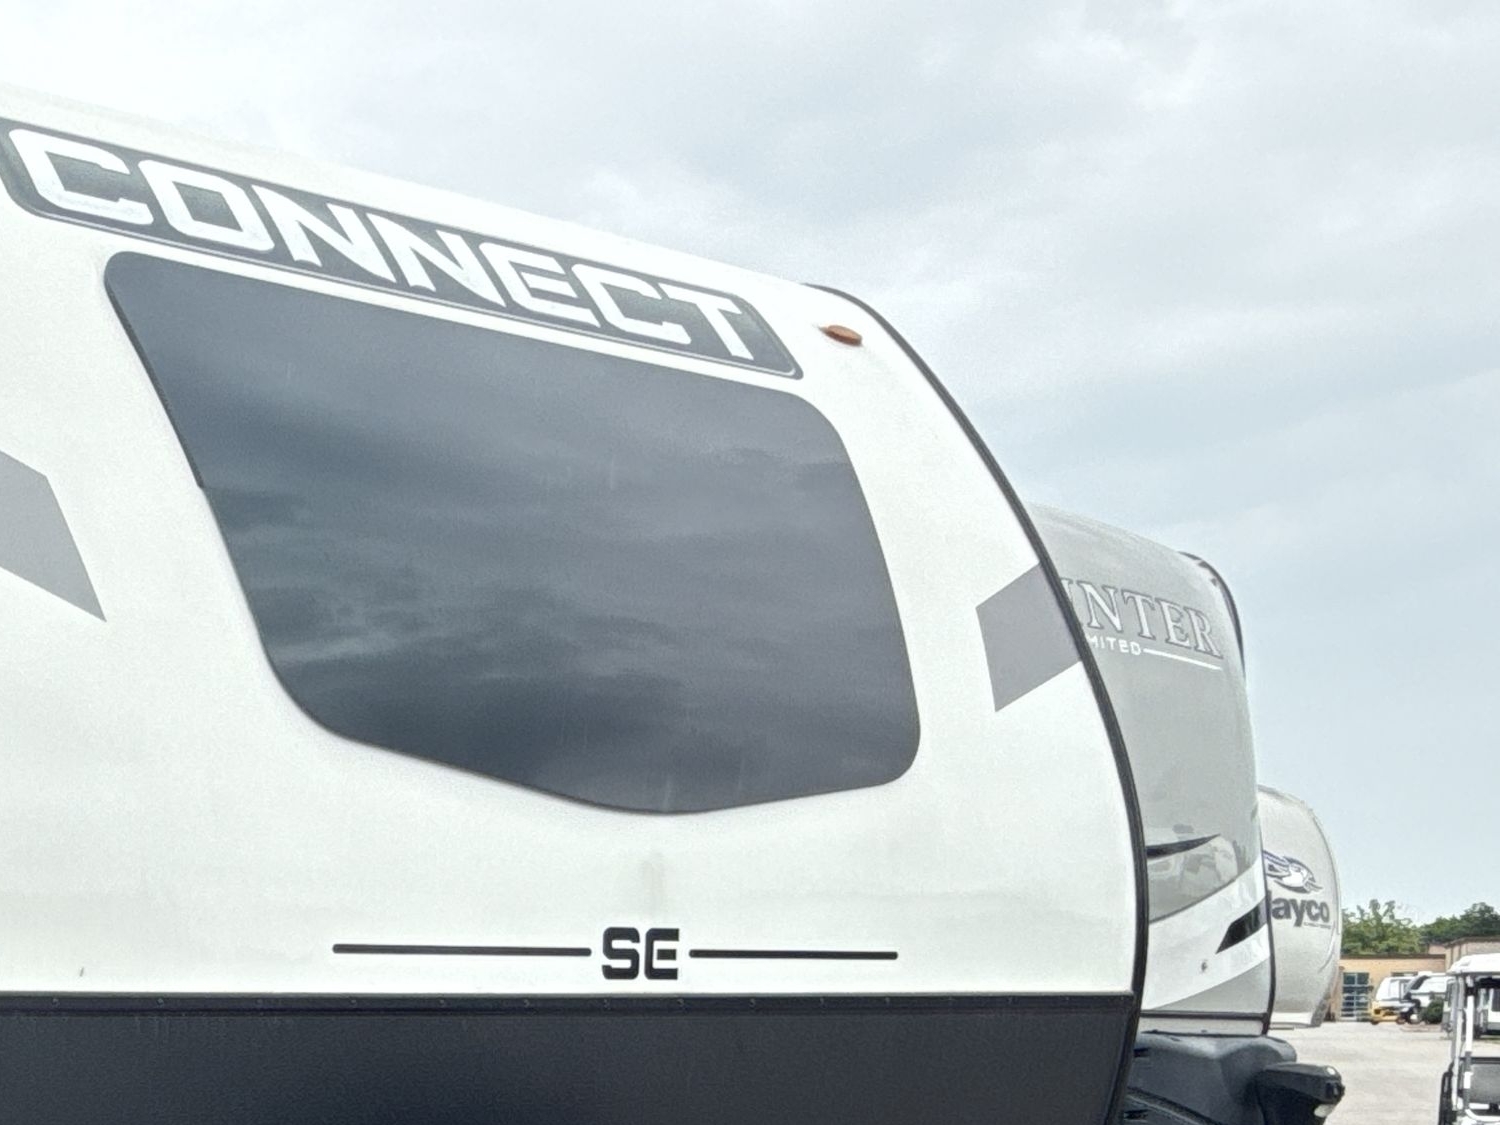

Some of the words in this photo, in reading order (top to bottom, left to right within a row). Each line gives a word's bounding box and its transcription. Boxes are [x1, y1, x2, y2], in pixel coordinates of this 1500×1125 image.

[8, 128, 754, 361] CONNECT
[1267, 890, 1330, 927] ayco
[601, 926, 680, 980] SE
